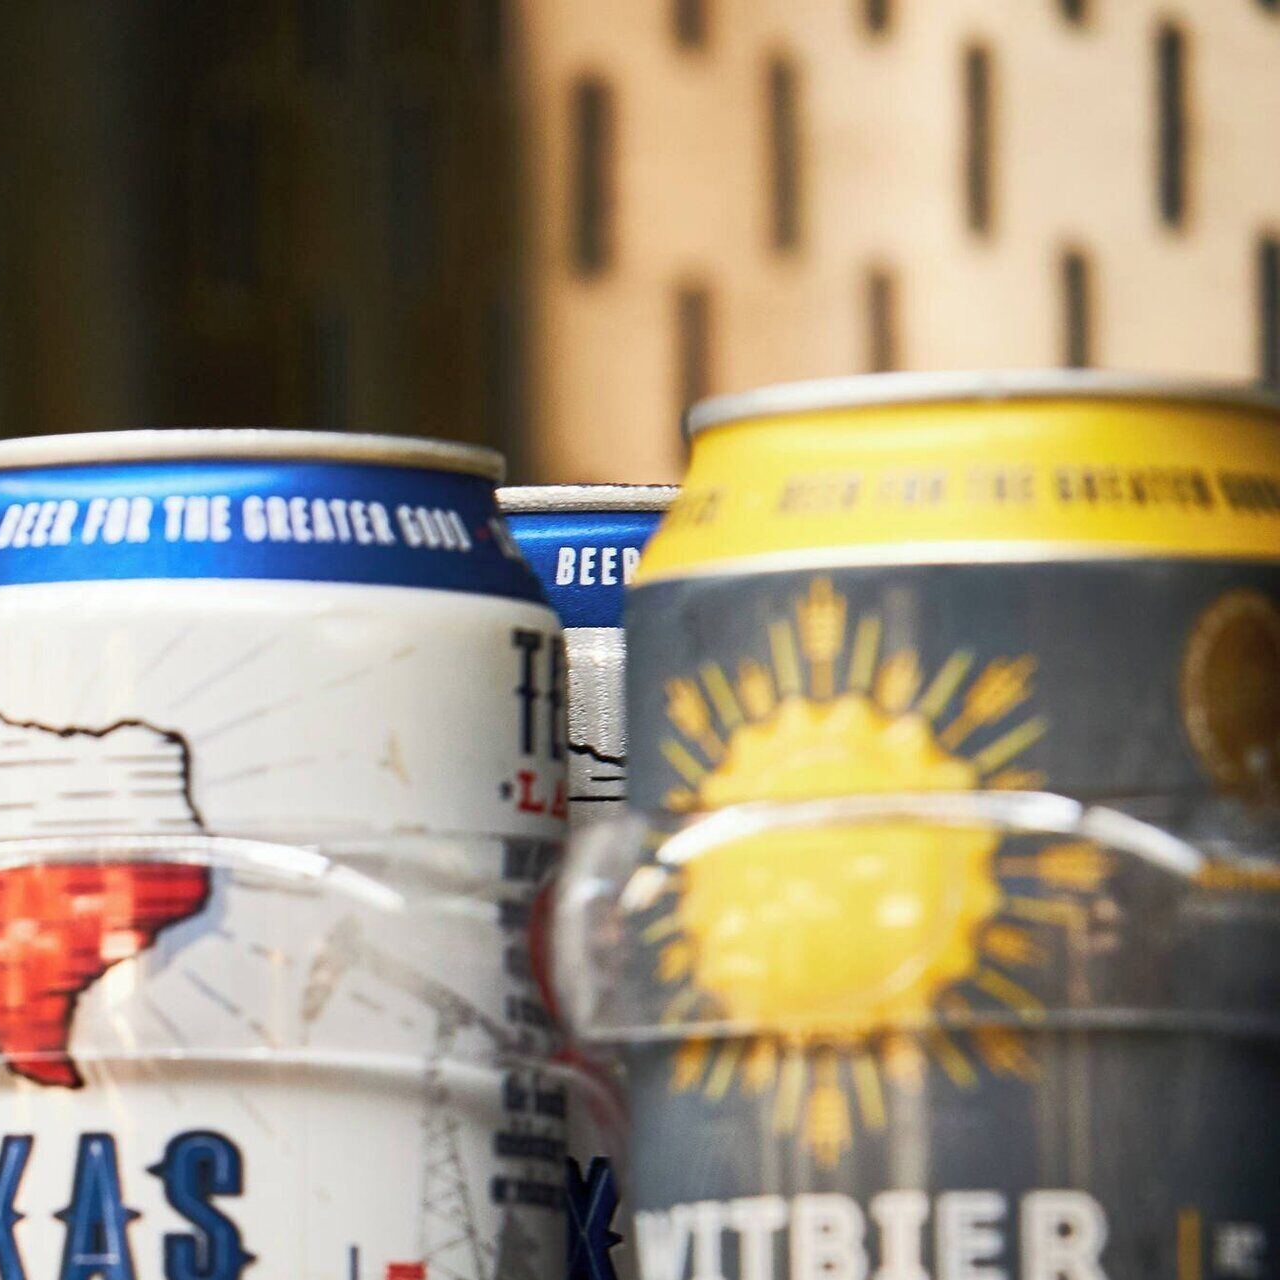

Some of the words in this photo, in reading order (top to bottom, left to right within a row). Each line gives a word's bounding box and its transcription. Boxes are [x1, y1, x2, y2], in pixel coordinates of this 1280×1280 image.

[82, 496, 153, 544] FOR
[164, 495, 231, 542] THE
[242, 495, 395, 544] GREATER
